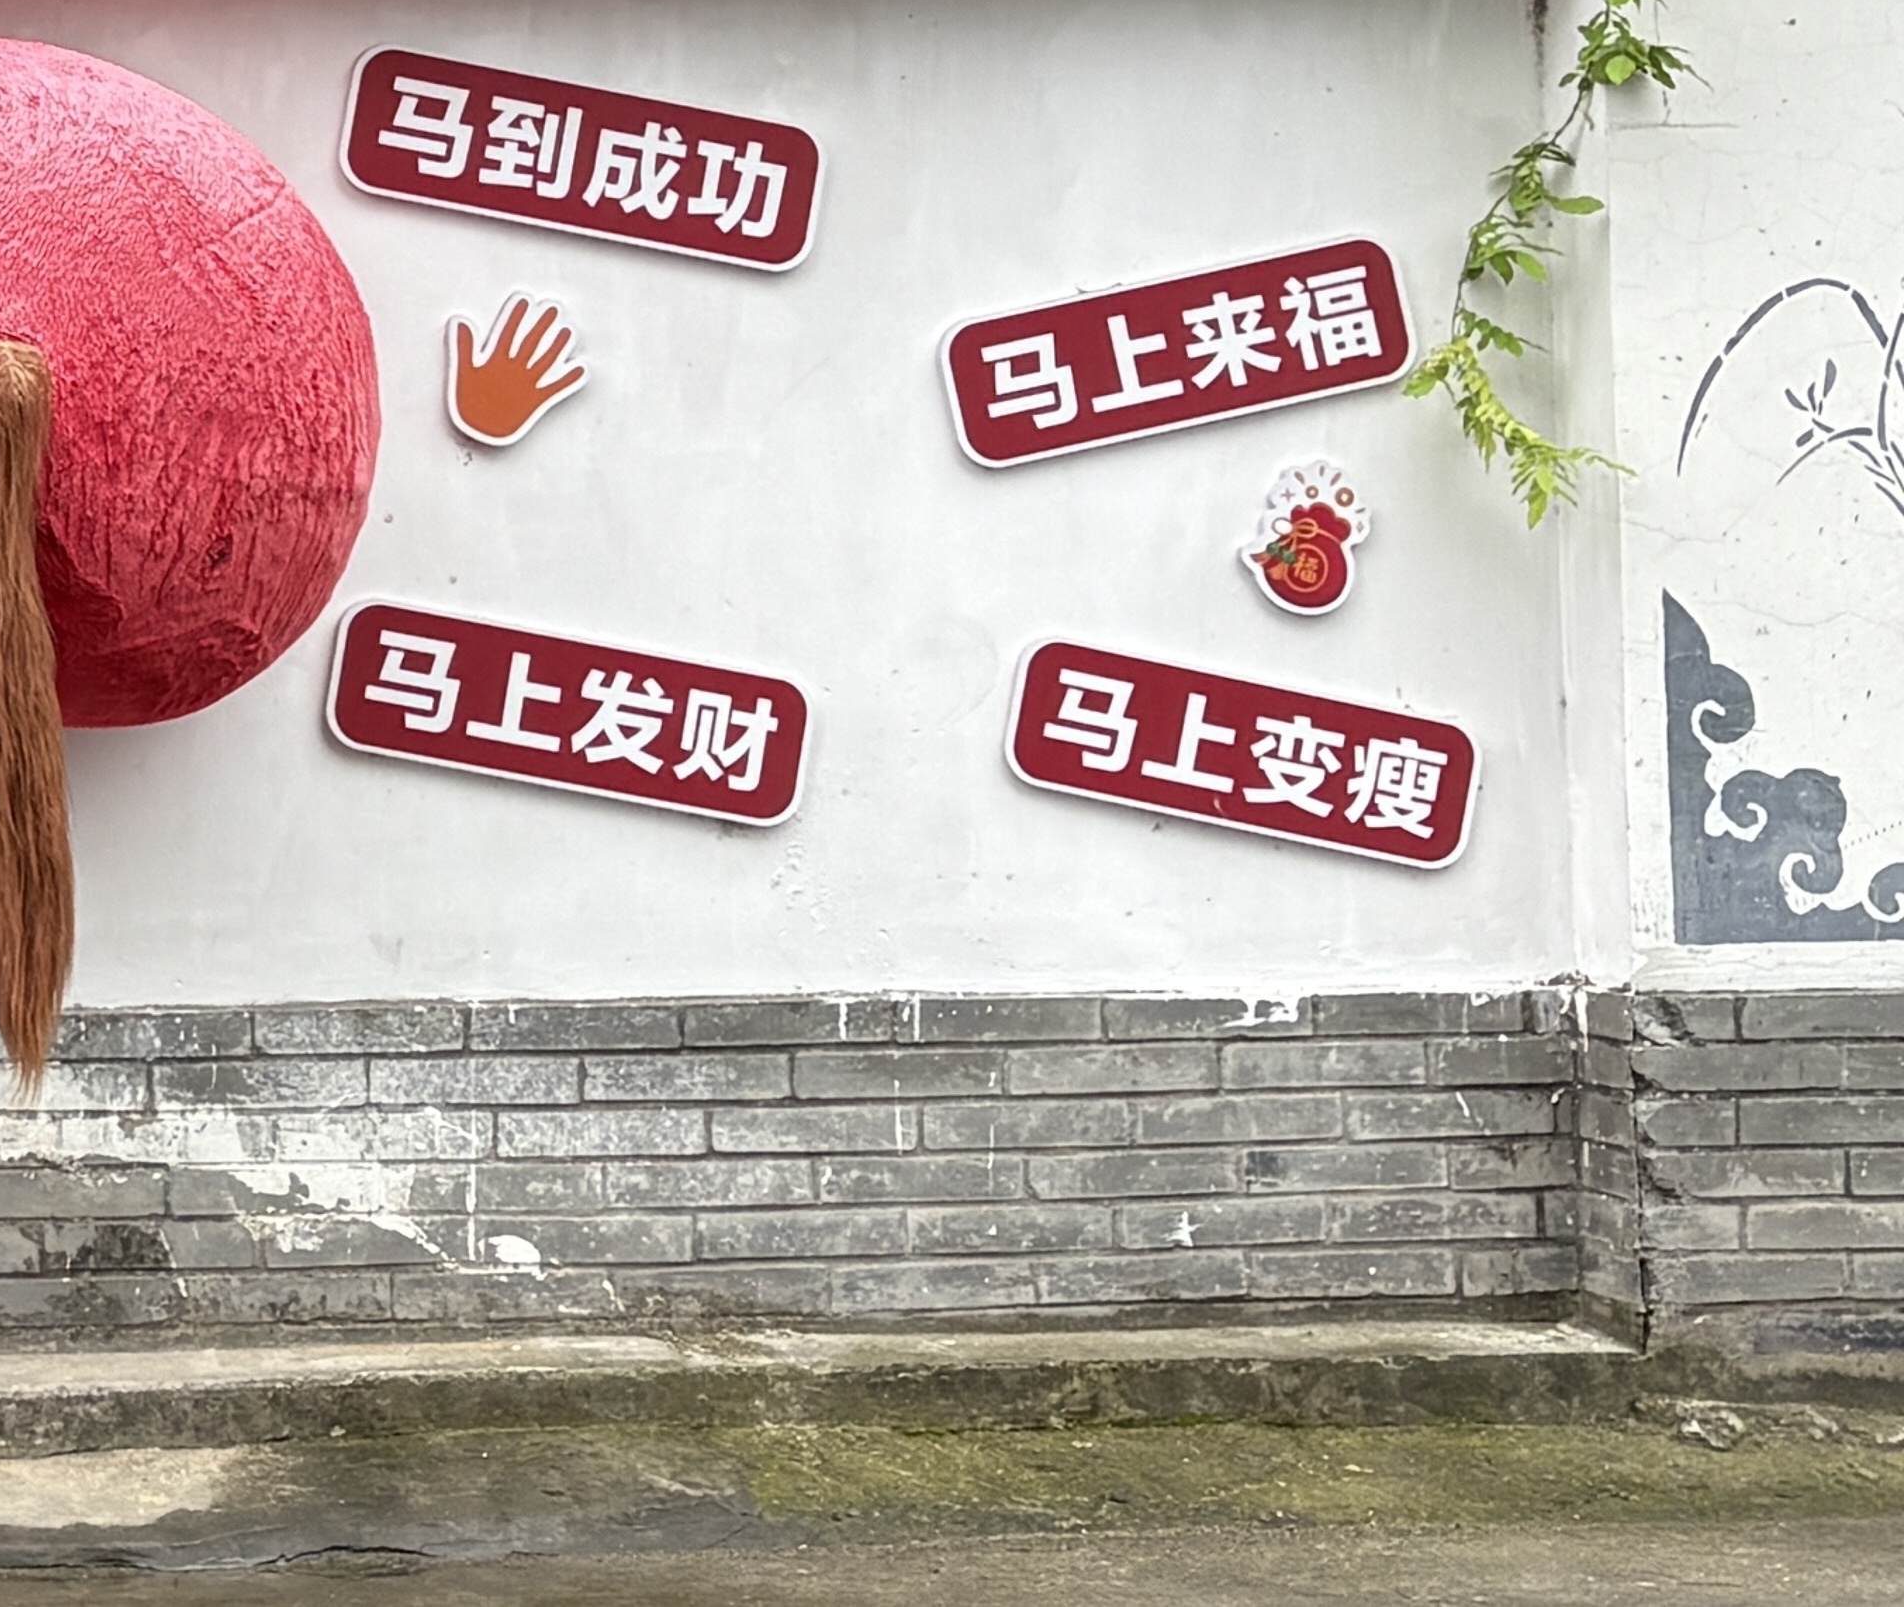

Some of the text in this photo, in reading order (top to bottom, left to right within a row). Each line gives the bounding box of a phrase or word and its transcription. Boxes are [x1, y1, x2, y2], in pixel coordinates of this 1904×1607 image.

[377, 76, 787, 239] 马到成功
[981, 264, 1383, 430] 马上来福
[1294, 552, 1320, 584] 福
[364, 630, 778, 793] 马上发财
[1043, 668, 1448, 840] 马上变瘦
